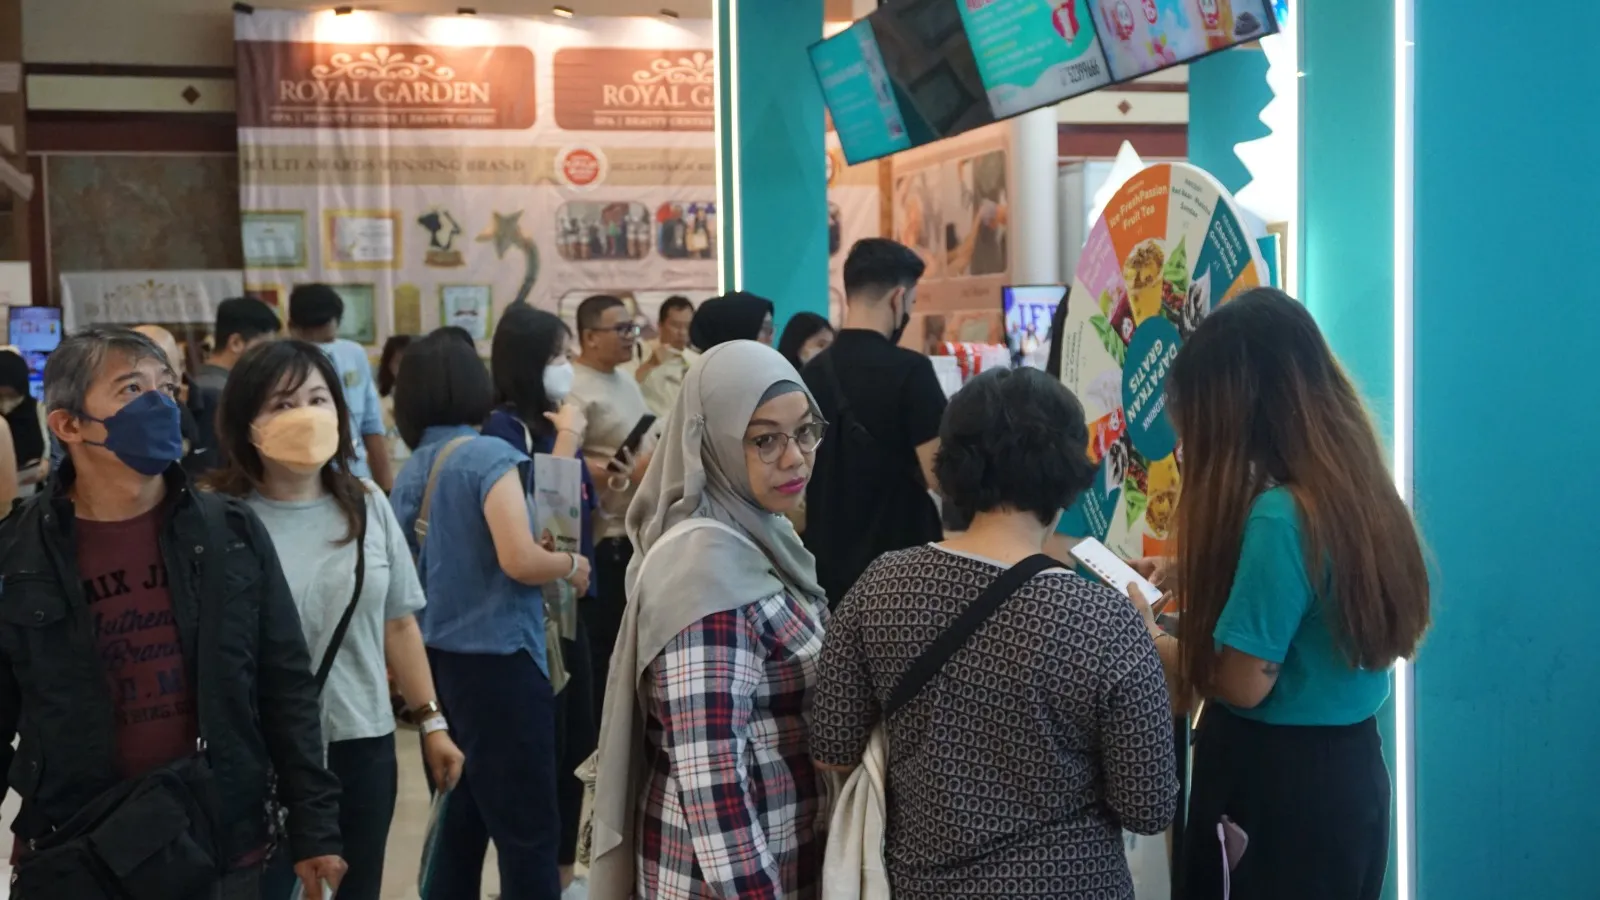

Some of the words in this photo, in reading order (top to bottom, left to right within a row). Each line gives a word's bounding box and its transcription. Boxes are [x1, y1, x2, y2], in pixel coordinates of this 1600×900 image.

[280, 80, 369, 103] ROYAL
[373, 80, 490, 104] GARDEN
[603, 84, 687, 107] ROYAL
[690, 84, 715, 107] G
[1213, 220, 1239, 268] Chocolate
[1127, 341, 1179, 425] DAPATKAN
[1128, 338, 1163, 395] GRATIS
